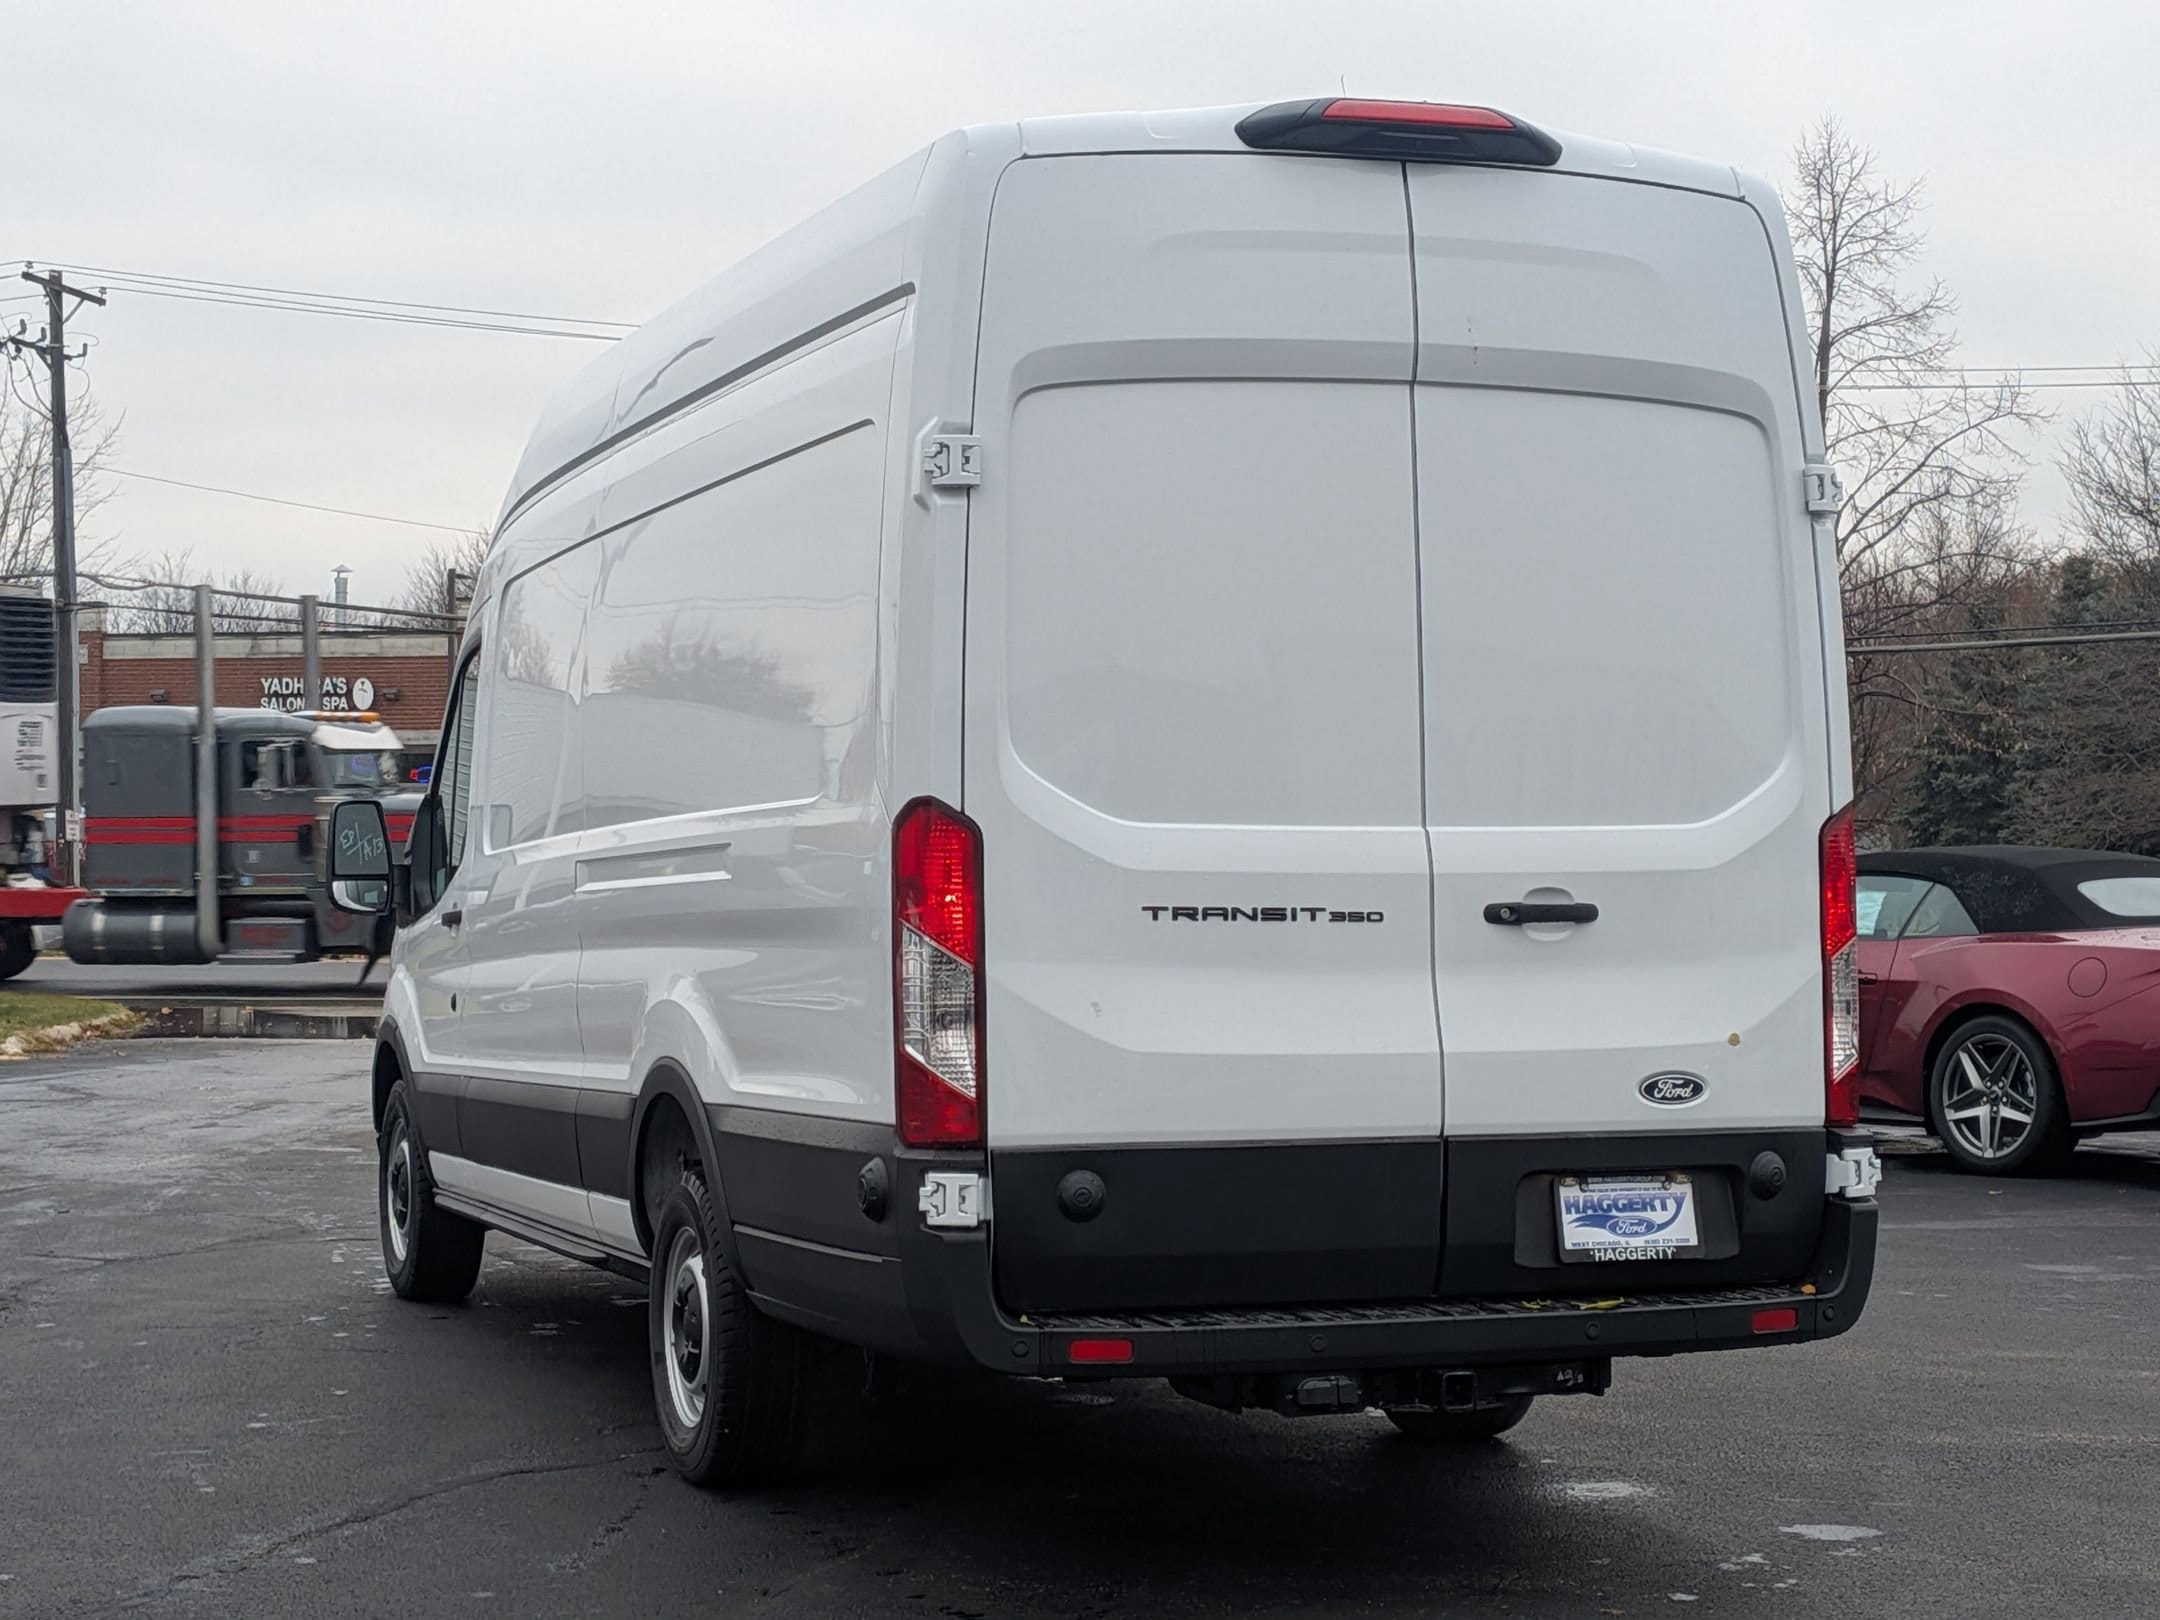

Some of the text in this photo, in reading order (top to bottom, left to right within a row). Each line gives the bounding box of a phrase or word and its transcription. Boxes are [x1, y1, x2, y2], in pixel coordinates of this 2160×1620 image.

[260, 677, 348, 694] YADHA'S
[260, 696, 349, 711] SALON SPA
[1141, 906, 1384, 923] TRANSIT 350
[1653, 1079, 1694, 1098] Ford
[1563, 1192, 1687, 1215] HAGGERTY
[1616, 1219, 1646, 1234] Ford
[1594, 1247, 1674, 1262] HAGGERTY
